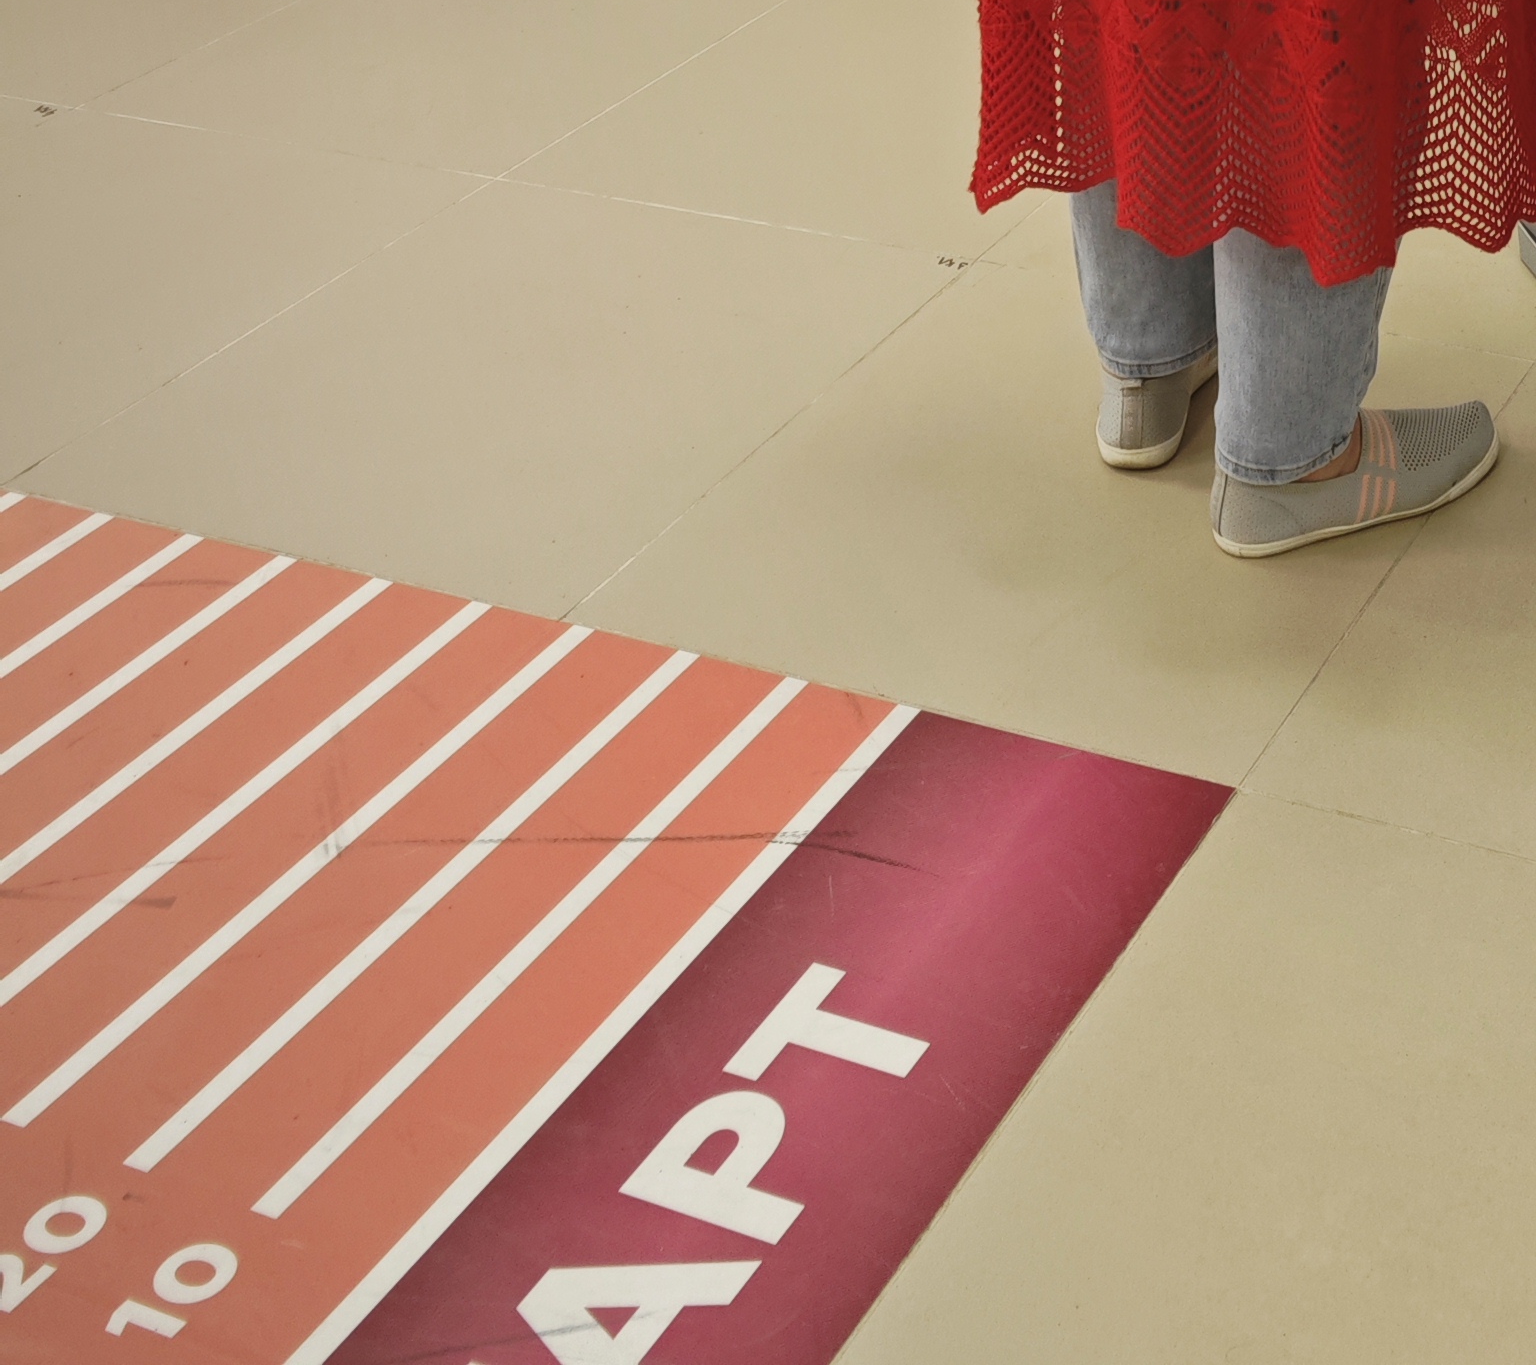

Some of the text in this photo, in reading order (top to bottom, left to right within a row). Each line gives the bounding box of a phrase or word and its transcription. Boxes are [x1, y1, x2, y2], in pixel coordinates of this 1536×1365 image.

[465, 959, 931, 1365] АРТ
[0, 1194, 108, 1314] 20
[104, 1242, 239, 1340] 10
